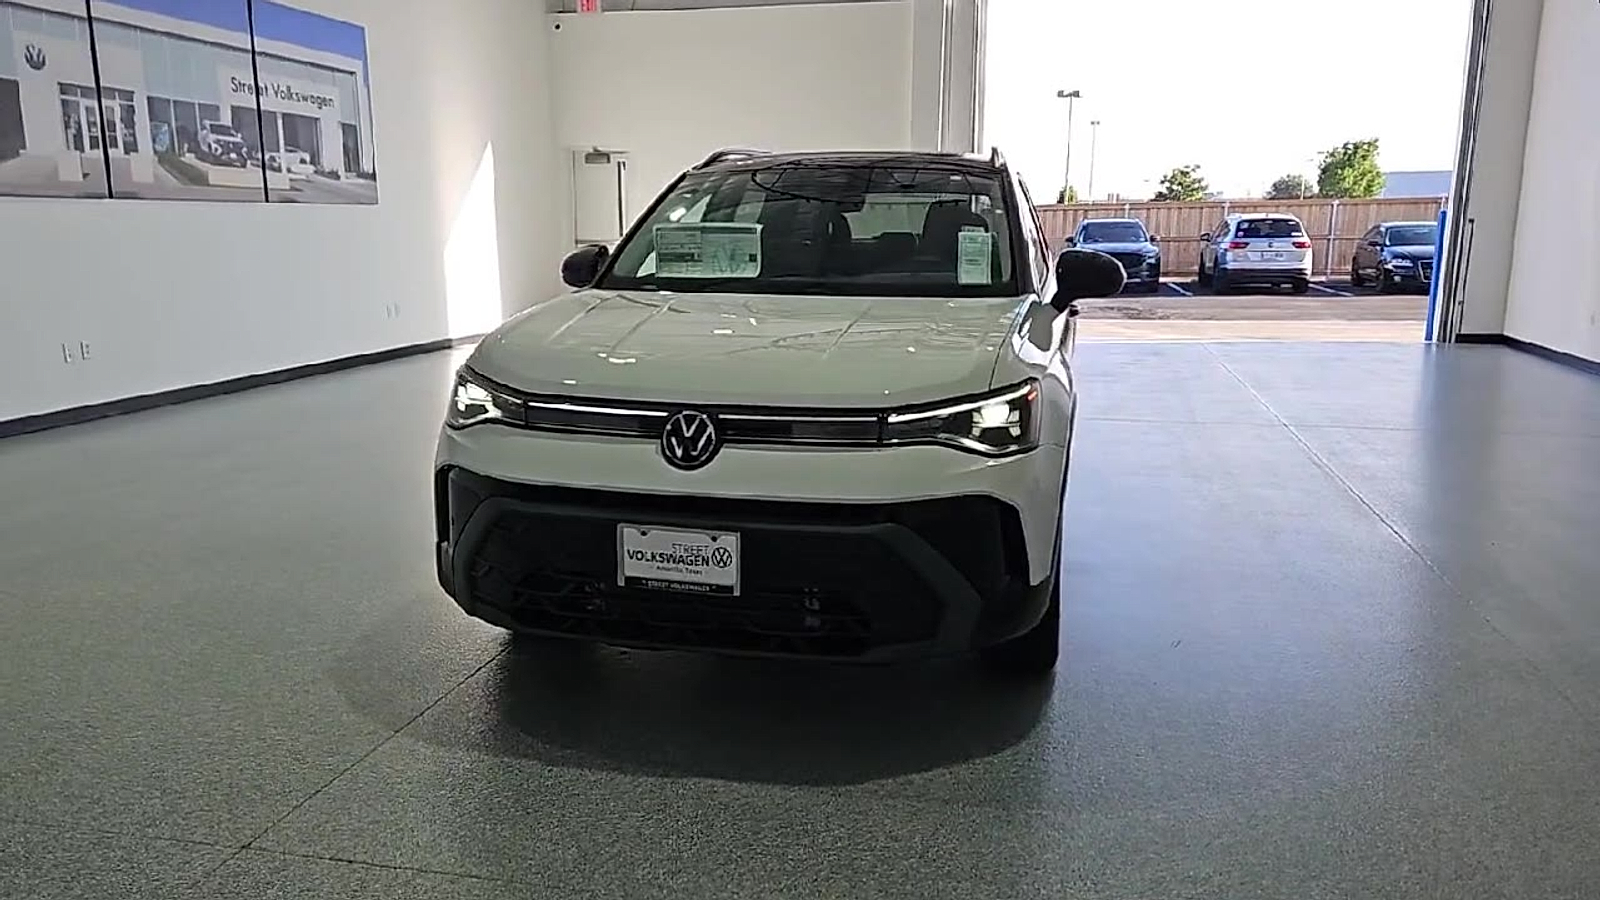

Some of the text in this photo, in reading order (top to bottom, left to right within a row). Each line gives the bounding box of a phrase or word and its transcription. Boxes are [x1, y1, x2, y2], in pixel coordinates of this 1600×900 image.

[272, 83, 335, 110] Volkswagen
[626, 548, 710, 567] VOLKSWAGEN
[671, 542, 710, 556] STREET
